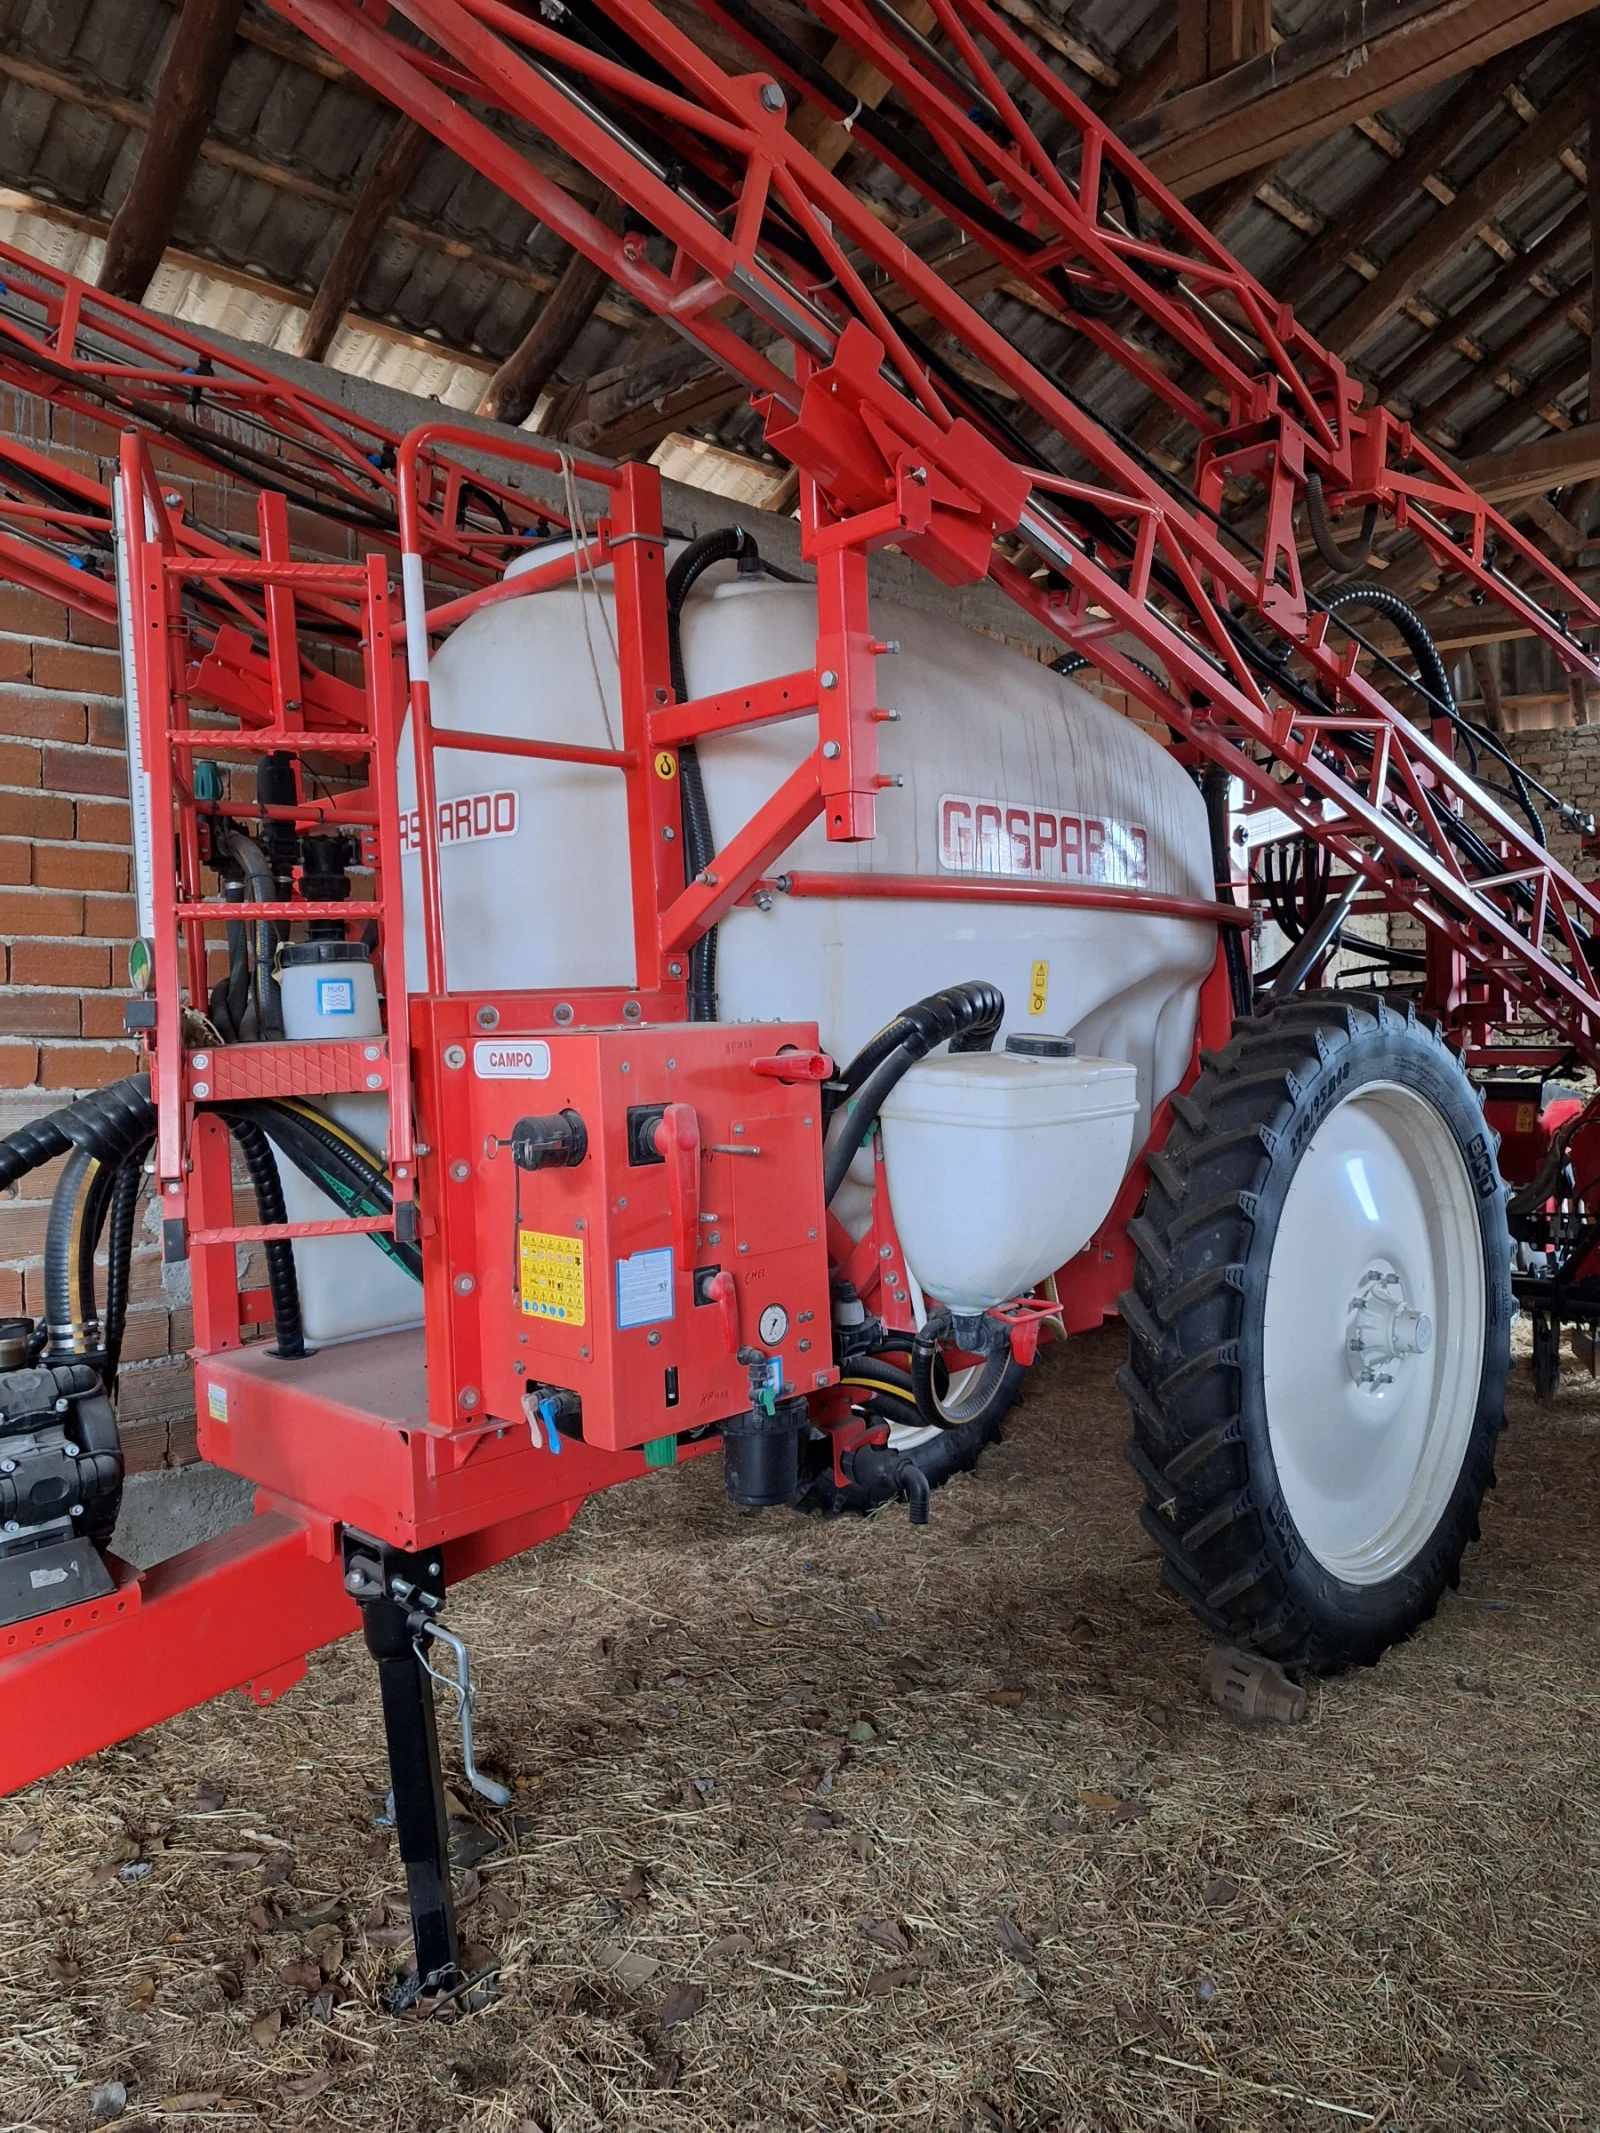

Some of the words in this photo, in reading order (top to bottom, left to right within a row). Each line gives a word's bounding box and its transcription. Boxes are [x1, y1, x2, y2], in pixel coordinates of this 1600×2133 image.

[399, 792, 515, 851] ASARDO
[943, 800, 1148, 881] GASPARO
[489, 1052, 533, 1068] CAMPO
[1468, 1132, 1498, 1199] BKT
[1266, 1491, 1301, 1572] BKT
